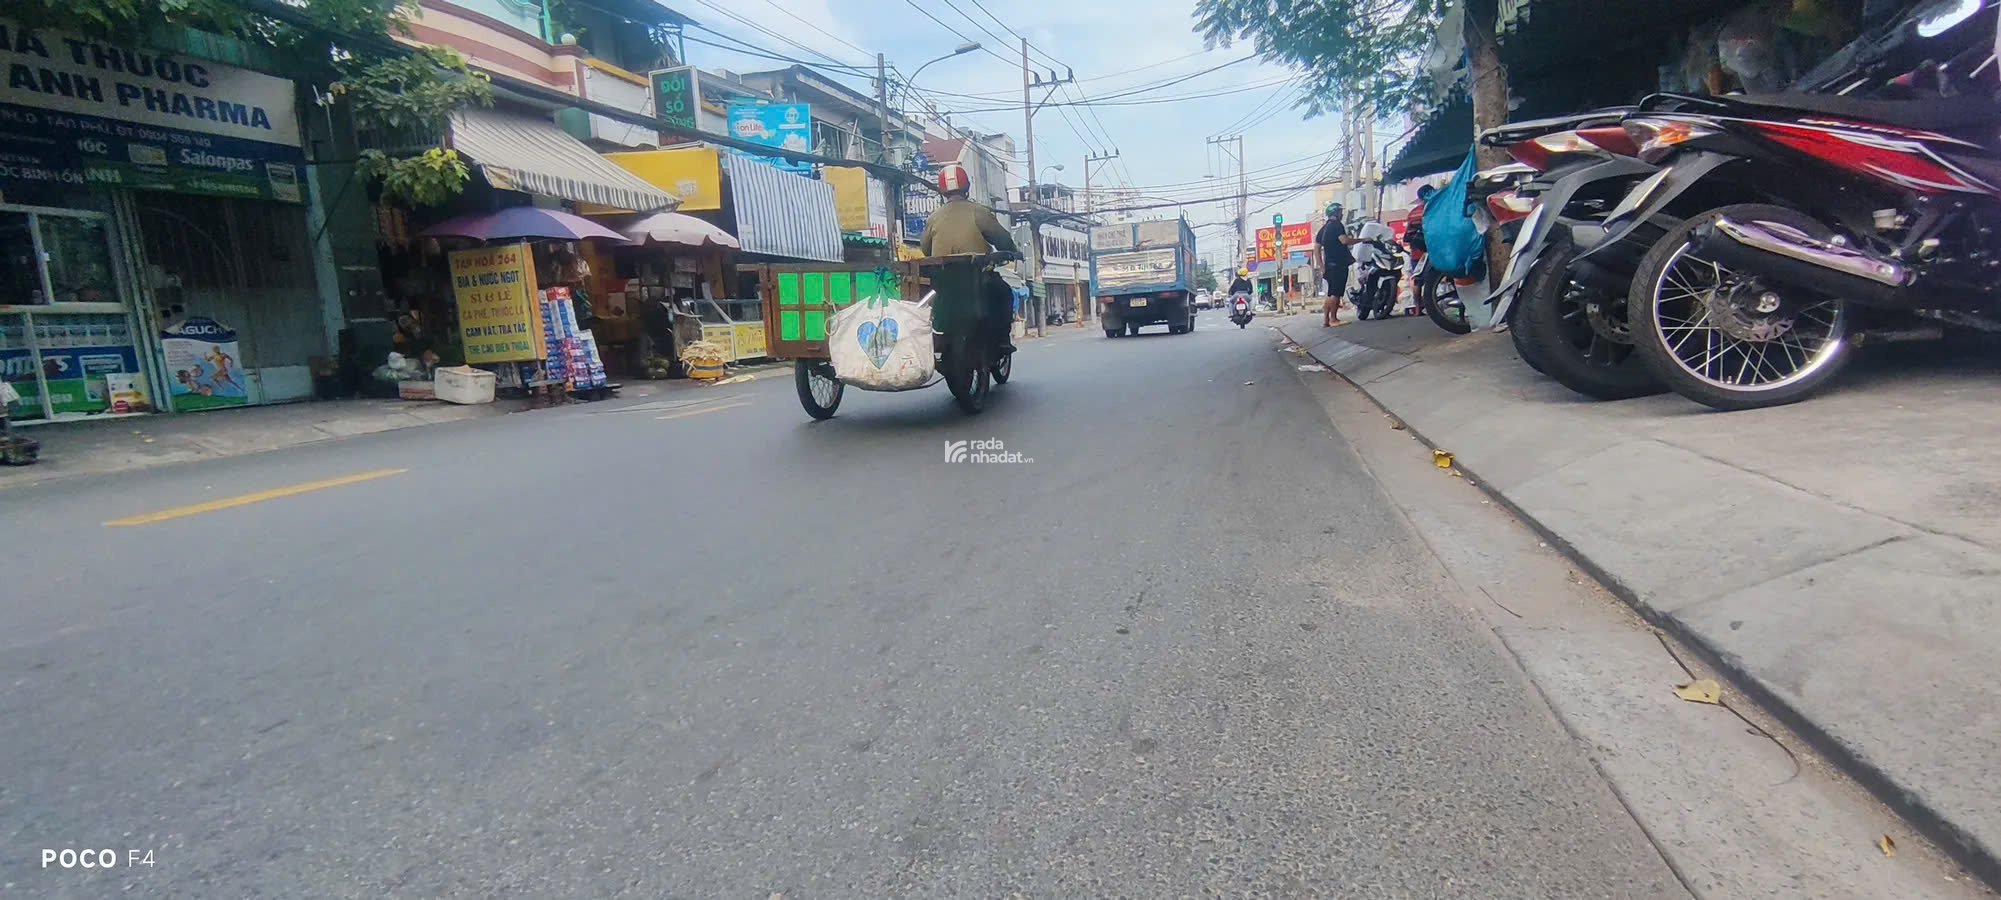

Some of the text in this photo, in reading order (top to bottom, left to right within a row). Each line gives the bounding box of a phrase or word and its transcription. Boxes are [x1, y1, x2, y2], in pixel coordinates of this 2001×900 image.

[9, 63, 271, 129] ANH PHARMA
[180, 148, 255, 172] Salonpas
[471, 275, 478, 287] &
[466, 327, 481, 338] CAM
